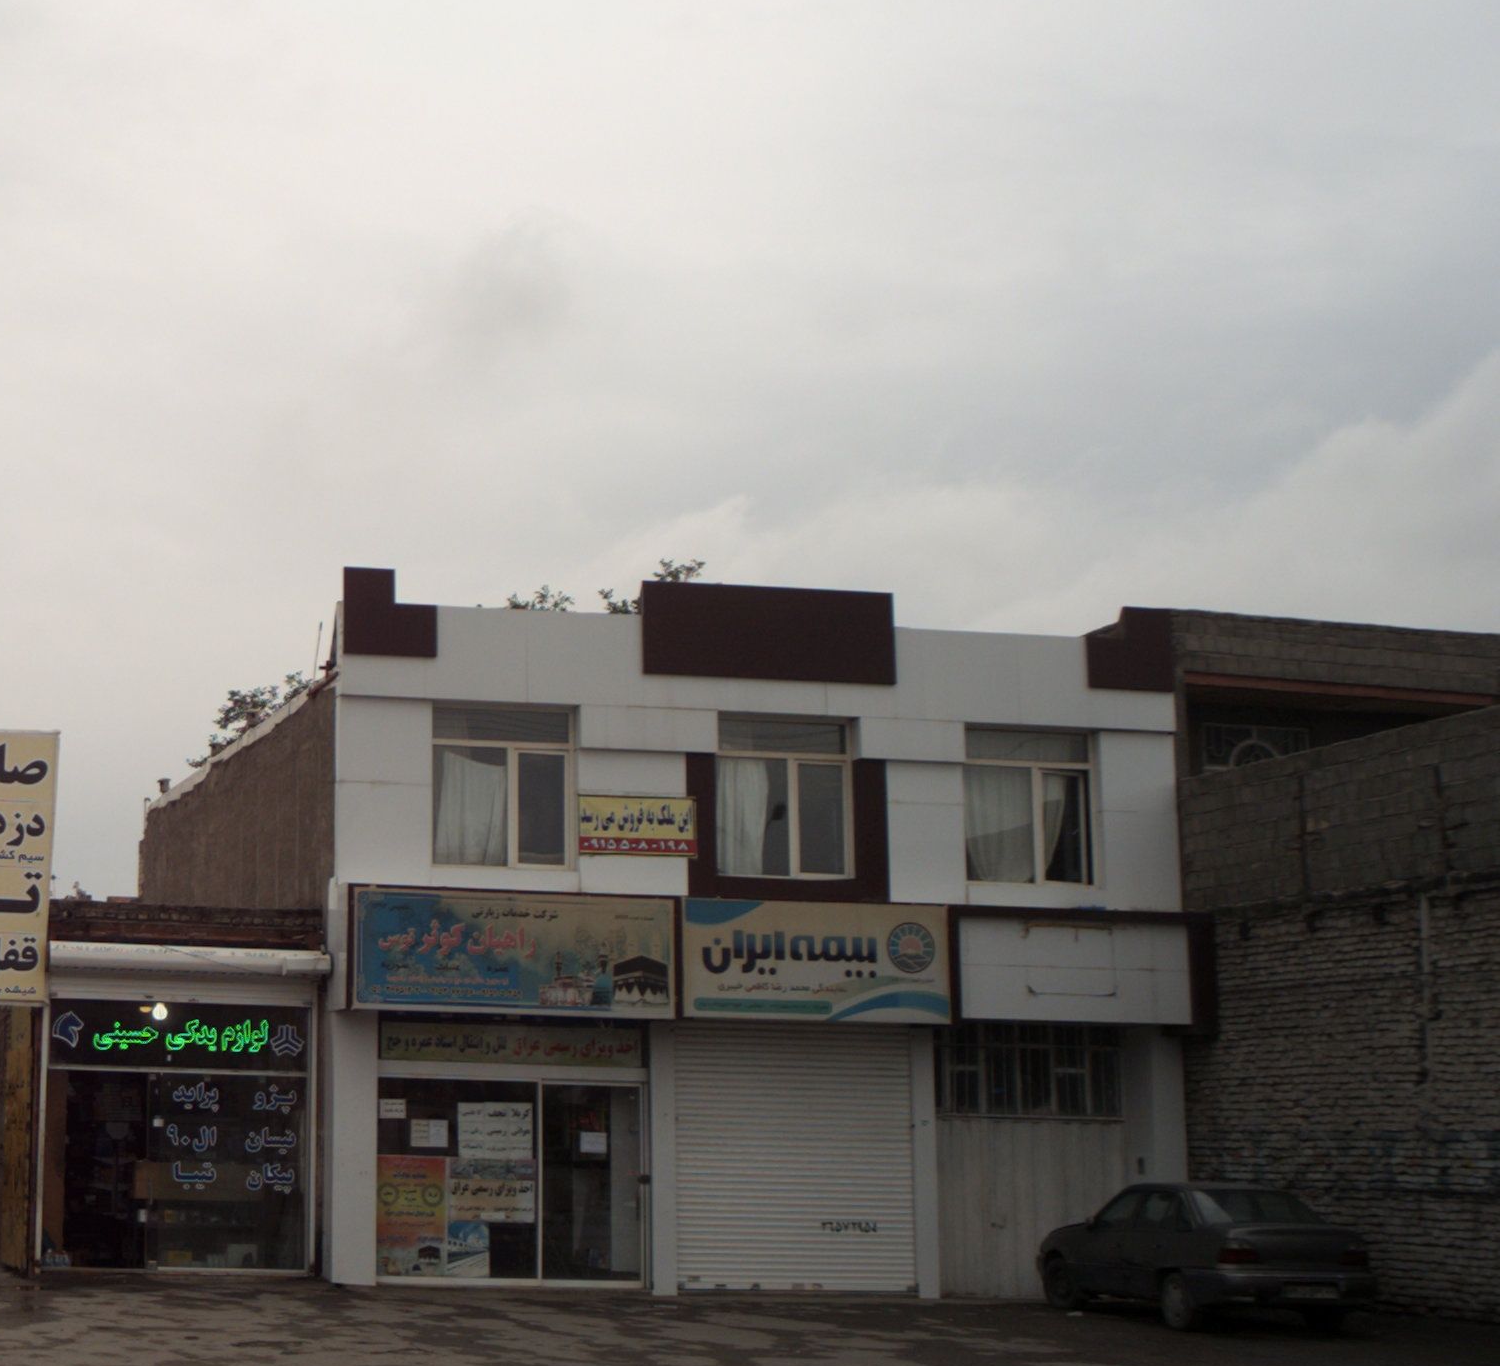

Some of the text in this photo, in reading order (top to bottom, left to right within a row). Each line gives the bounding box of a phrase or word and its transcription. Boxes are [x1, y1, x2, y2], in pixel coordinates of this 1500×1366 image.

[618, 802, 644, 832] فروش
[657, 804, 675, 826] ملک
[18, 852, 45, 863] سیم
[501, 907, 531, 919] خدمات
[533, 908, 559, 921] شرکت
[418, 919, 466, 956] کوثر
[467, 923, 537, 960] راهیان
[702, 930, 877, 979] بیمه ایران
[92, 1018, 270, 1052] لوازم یدکی حسینی
[172, 1081, 220, 1113] پراید
[252, 1084, 297, 1115] پژو
[245, 1126, 297, 1154] نیسان
[172, 1161, 217, 1190] تیبا
[246, 1162, 295, 1194] پیکان
